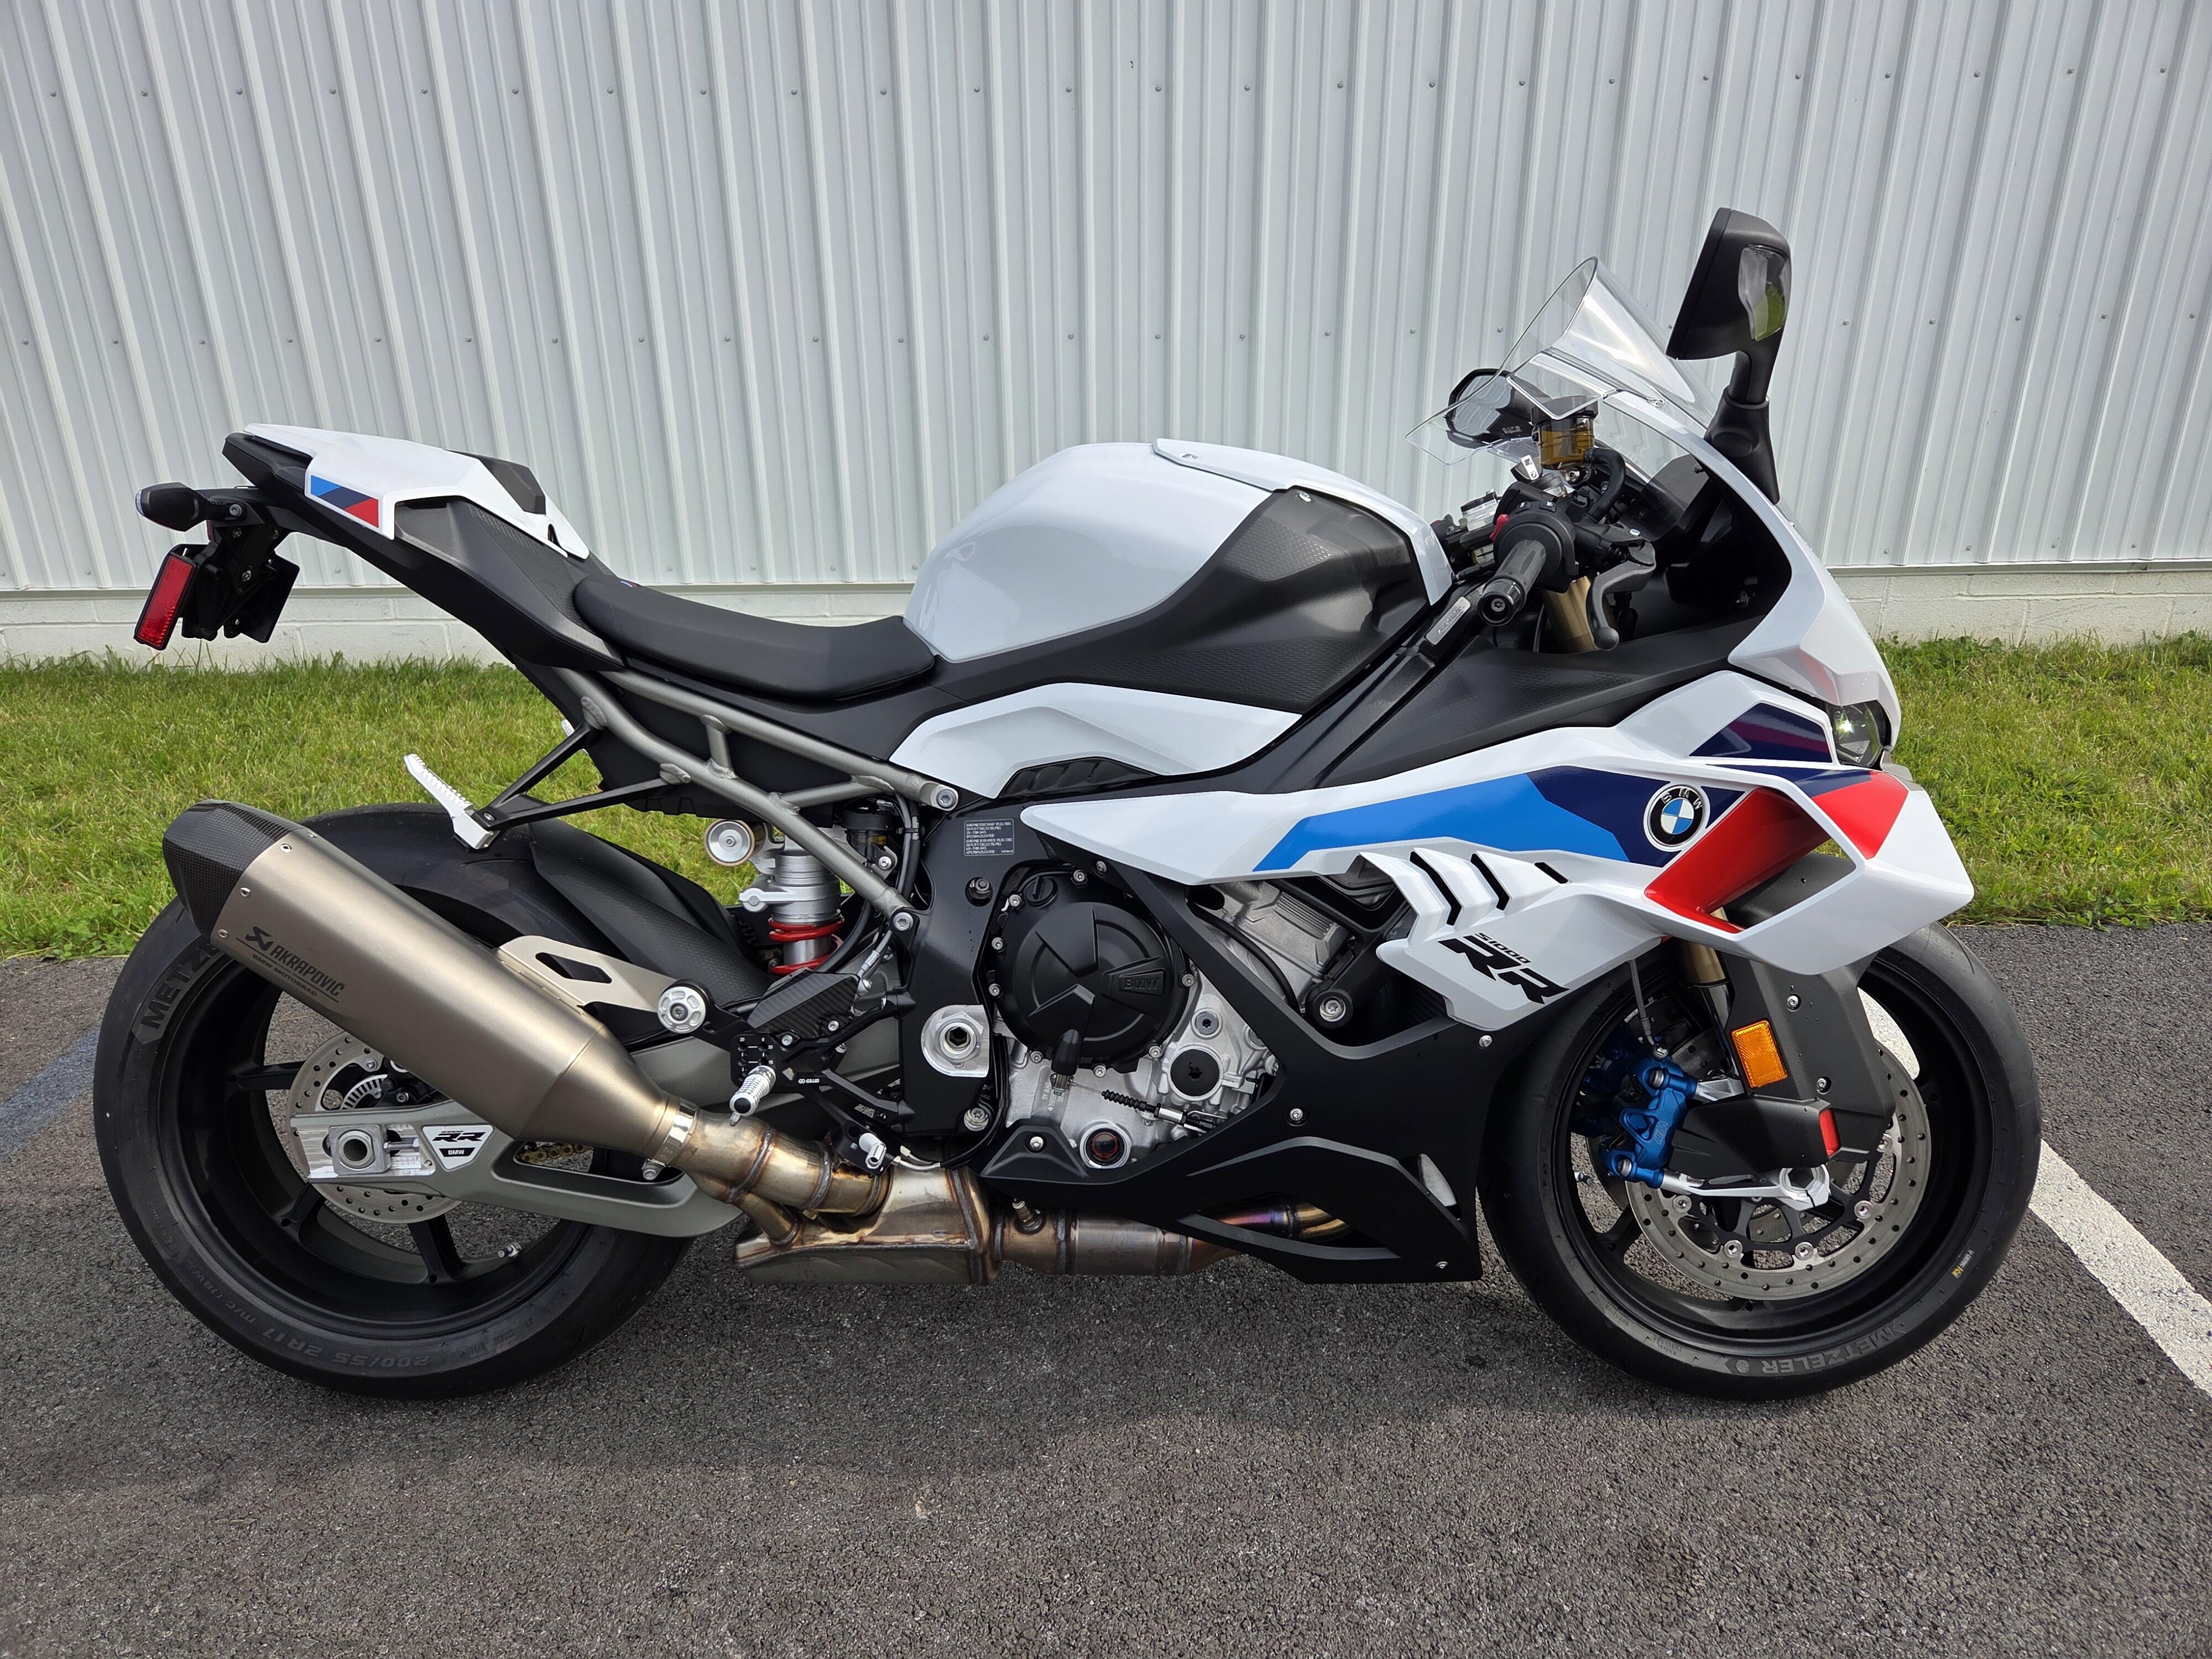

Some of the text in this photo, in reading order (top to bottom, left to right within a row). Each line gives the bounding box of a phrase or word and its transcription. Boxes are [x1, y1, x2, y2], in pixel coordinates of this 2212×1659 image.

[1661, 787, 1702, 810] BMW
[1474, 932, 1532, 963] S1000
[253, 954, 317, 996] BMW MOTORRAD
[1124, 978, 1160, 990] BMW
[1437, 935, 1570, 1004] RR
[432, 1132, 486, 1142] RR
[1761, 1326, 1894, 1374] METZELER
